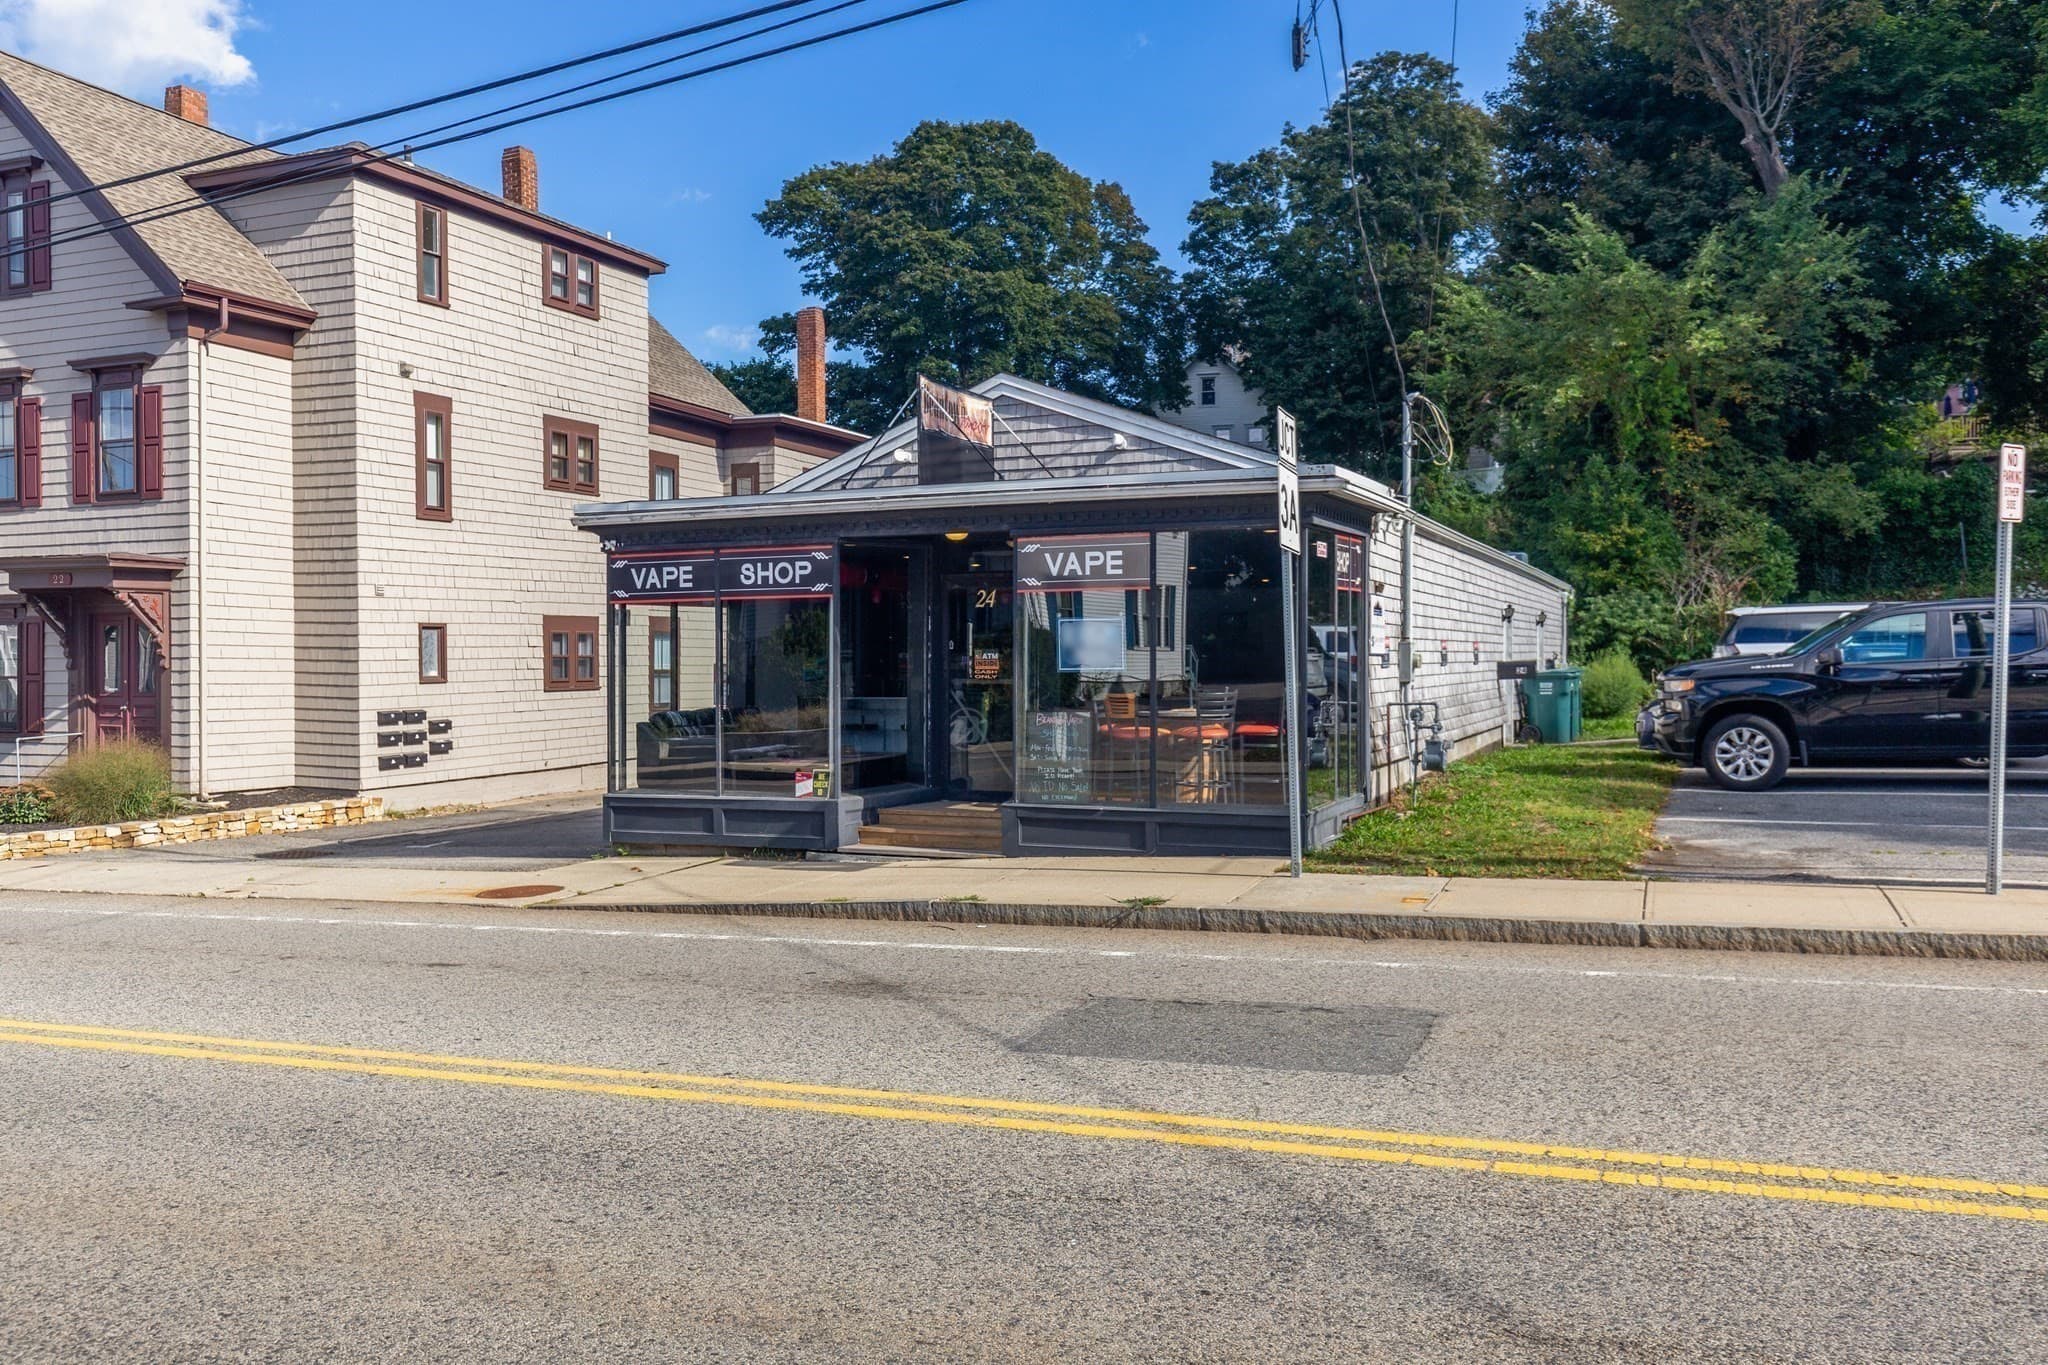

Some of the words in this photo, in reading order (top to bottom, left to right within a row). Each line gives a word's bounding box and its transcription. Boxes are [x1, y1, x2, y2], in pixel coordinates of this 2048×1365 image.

[1280, 419, 1294, 458] JCT
[2008, 454, 2017, 467] NO
[1281, 484, 1298, 534] 3A
[631, 566, 693, 589] VAPE
[740, 561, 812, 585] SHOP
[1044, 550, 1123, 576] VAPE
[52, 575, 64, 584] 22
[975, 589, 996, 608] 24
